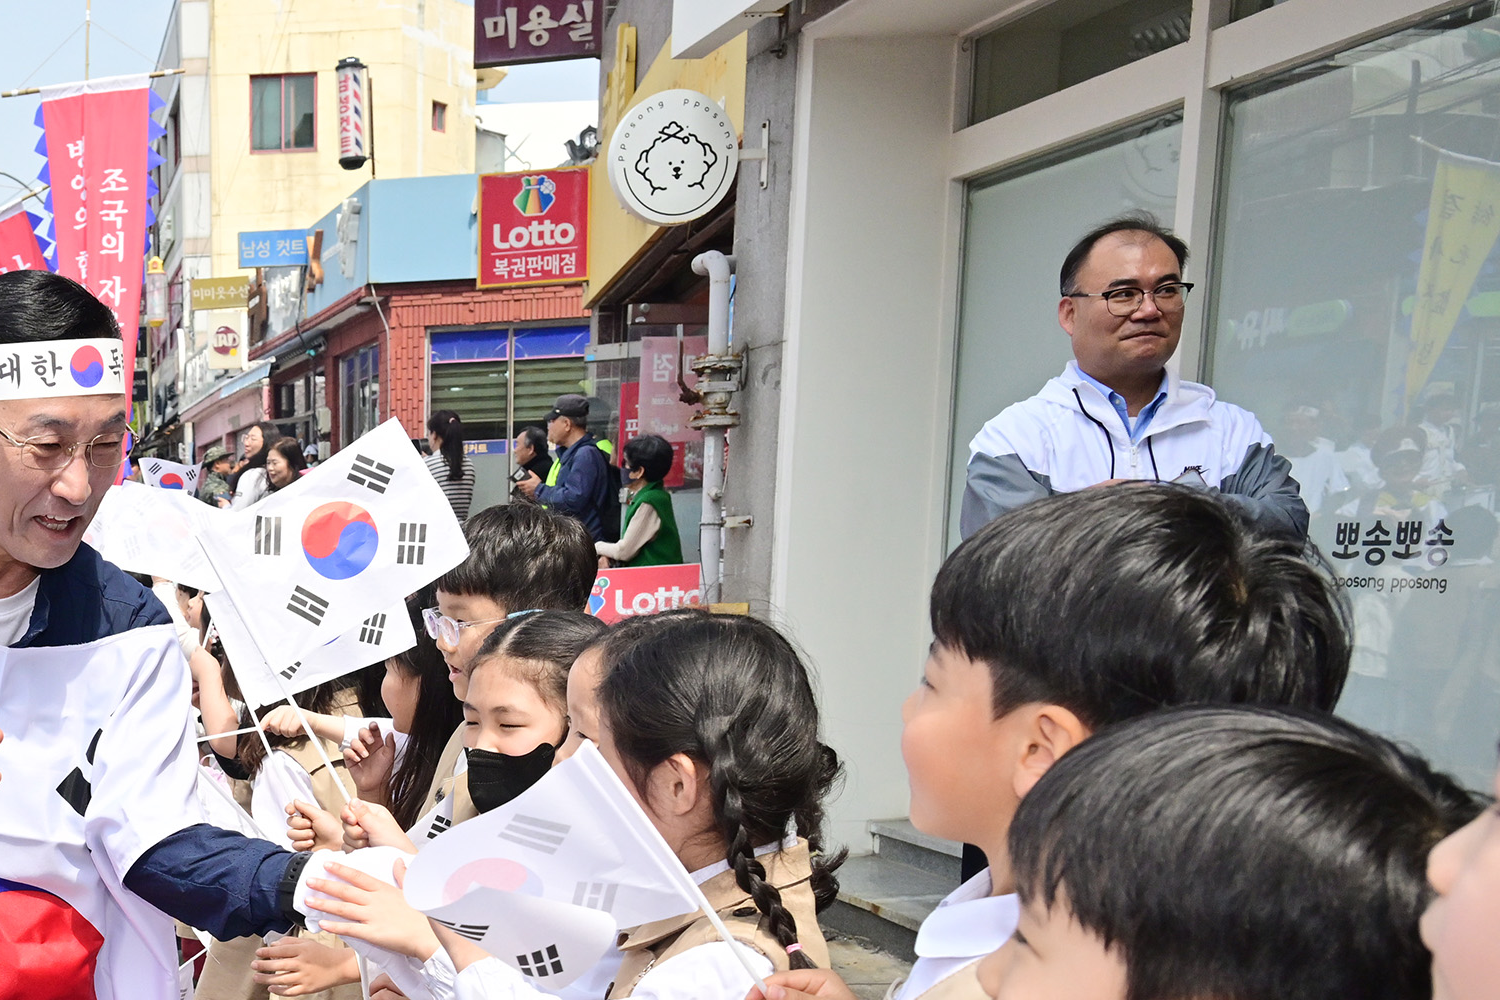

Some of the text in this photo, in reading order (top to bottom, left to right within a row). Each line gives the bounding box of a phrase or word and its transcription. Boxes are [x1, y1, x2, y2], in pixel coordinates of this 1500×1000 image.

[483, 0, 594, 49] 미용실
[617, 98, 734, 161] pposong pposong
[99, 168, 129, 262] 조국의
[242, 239, 306, 258] 남성 컷트
[493, 220, 576, 249] Lotto
[493, 252, 576, 279] 복권판매점
[193, 284, 251, 300] 미미옷수선
[108, 347, 125, 383] 독
[1332, 519, 1455, 567] 뽀송뽀송
[1390, 577, 1447, 594] pposong
